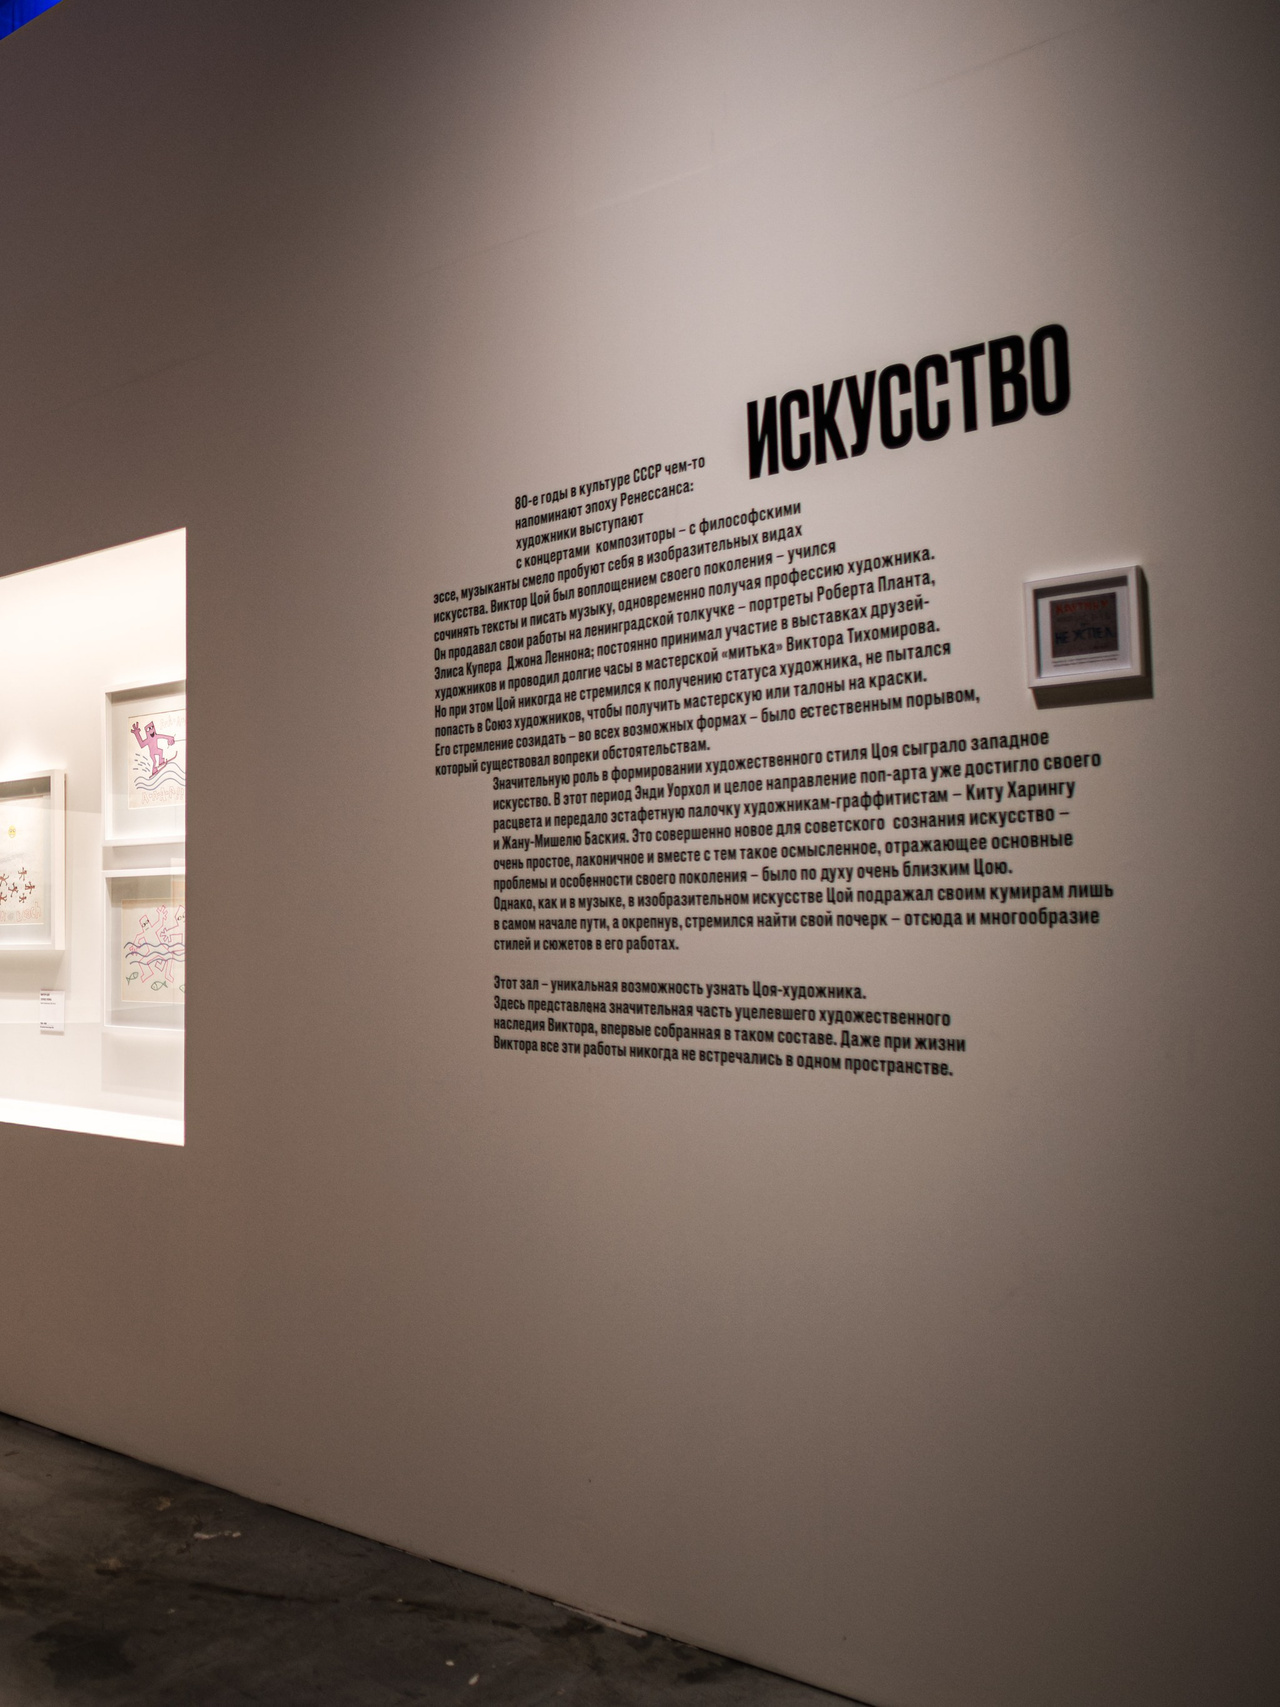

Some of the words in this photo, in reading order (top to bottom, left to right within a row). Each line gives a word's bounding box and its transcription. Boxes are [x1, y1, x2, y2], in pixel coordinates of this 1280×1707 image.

[746, 323, 1071, 480] ИСКУССТВО
[514, 494, 539, 510] 80-е
[540, 488, 568, 505] годы
[570, 486, 577, 498] в
[579, 474, 631, 498] культуре
[633, 463, 662, 483] СССР
[664, 456, 705, 476] чем-то
[515, 505, 583, 530] напоминают
[585, 497, 618, 515] эпоху
[620, 481, 694, 507] Ренессанса:
[515, 526, 577, 552] художники
[579, 512, 644, 536] выступают
[433, 590, 459, 604] эссе,
[460, 578, 520, 601] музыканты
[522, 571, 555, 588] смело
[557, 562, 606, 584] пробуют
[607, 554, 635, 572] себя
[637, 554, 644, 566] в
[646, 533, 759, 565] изобразительных
[761, 524, 803, 543] видах
[433, 625, 480, 642] сочинять
[481, 618, 519, 634] тексты
[520, 616, 528, 628] и
[529, 610, 567, 626] писать
[569, 602, 616, 622] музыку,
[618, 586, 706, 613] одновременно
[708, 577, 762, 597] получая
[764, 563, 844, 590] профессию
[847, 548, 935, 576] художника.
[434, 666, 465, 680] Элиса
[466, 660, 502, 678] Купера
[506, 654, 543, 672] Джона
[544, 647, 595, 664] Леннона;
[596, 637, 658, 657] постоянно
[660, 627, 722, 650] принимал
[725, 619, 778, 642] участие
[781, 618, 789, 630] в
[791, 606, 868, 629] выставках
[870, 593, 930, 620] друзей-
[434, 681, 497, 702] художников
[499, 680, 506, 691] и
[507, 672, 560, 692] проводил
[561, 666, 602, 684] долгие
[603, 662, 633, 676] часы
[635, 660, 643, 672] в
[645, 647, 719, 671] мастерской
[721, 642, 783, 660] «митька»
[786, 632, 844, 652] Виктора
[847, 620, 940, 644] Тихомирова.
[434, 704, 447, 719] Но
[448, 704, 467, 719] при
[469, 701, 494, 714] этом
[495, 696, 516, 712] Цой
[518, 692, 562, 708] никогда
[564, 690, 577, 703] не
[579, 682, 642, 702] стремился
[644, 680, 652, 692] к
[653, 671, 723, 692] получению
[725, 664, 777, 683] статуса
[779, 654, 863, 679] художника,
[865, 651, 883, 665] не
[886, 642, 951, 663] пытался
[434, 723, 475, 738] попасть
[476, 722, 483, 733] в
[484, 717, 513, 732] Союз
[514, 710, 585, 732] художников,
[586, 703, 623, 720] чтобы
[625, 699, 681, 717] получить
[683, 689, 763, 709] мастерскую
[765, 686, 791, 700] или
[793, 679, 845, 697] талоны
[848, 677, 866, 691] на
[868, 670, 927, 691] краски.
[435, 759, 479, 777] который
[480, 754, 551, 775] существовал
[552, 750, 600, 767] вопреки
[602, 739, 711, 761] обстоятельствам.
[492, 773, 571, 791] Значительную
[572, 771, 600, 787] роль
[601, 770, 609, 782] в
[610, 762, 703, 784] формировании
[705, 751, 823, 776] художественного
[826, 747, 868, 763] стиля
[871, 742, 899, 761] Цоя
[902, 738, 967, 758] сыграло
[970, 731, 1050, 751] западное
[492, 796, 552, 813] искусство.
[553, 791, 561, 806] В
[563, 792, 588, 806] этот
[590, 789, 633, 806] период
[634, 784, 665, 801] Энди
[666, 782, 710, 800] Уорхол
[713, 782, 721, 794] и
[724, 779, 763, 795] целое
[766, 772, 857, 793] направление
[860, 766, 928, 785] поп-арта
[930, 764, 962, 783] уже
[964, 757, 1040, 779] достигло
[1043, 753, 1102, 771] своего
[493, 858, 524, 871] очень
[526, 856, 574, 872] простое,
[575, 852, 645, 867] лаконичное
[646, 852, 655, 864] и
[657, 850, 701, 864] вместе
[703, 849, 711, 862] с
[713, 848, 737, 861] тем
[739, 846, 778, 860] такое
[780, 842, 882, 859] осмысленное,
[884, 836, 988, 857] отражающее
[991, 832, 1074, 850] основные
[493, 936, 532, 951] стилей
[533, 939, 541, 950] и
[542, 939, 593, 951] сюжетов
[595, 939, 603, 951] в
[604, 938, 624, 950] его
[625, 935, 679, 954] работах.
[493, 995, 526, 1012] Здесь
[527, 999, 607, 1014] представлена
[608, 1002, 694, 1017] значительная
[695, 1005, 733, 1018] часть
[734, 1006, 816, 1022] уцелевшего
[818, 1009, 951, 1027] художественного
[493, 1018, 546, 1033] наследия
[547, 1017, 598, 1037] Виктора,
[600, 1023, 652, 1039] впервые
[653, 1022, 721, 1042] собранная
[723, 1028, 732, 1041] в
[733, 1029, 775, 1043] таком
[777, 1030, 838, 1046] составе.
[839, 1029, 881, 1049] Даже
[884, 1035, 912, 1053] при
[914, 1037, 966, 1052] жизни
[493, 1034, 539, 1054] Виктора
[540, 1040, 560, 1053] все
[561, 1042, 581, 1054] эти
[583, 1040, 627, 1058] работы
[629, 1046, 679, 1062] никогда
[681, 1049, 696, 1062] не
[698, 1049, 783, 1066] встречались
[785, 1054, 794, 1067] в
[796, 1054, 842, 1070] одном
[844, 1057, 954, 1077] пространстве.
